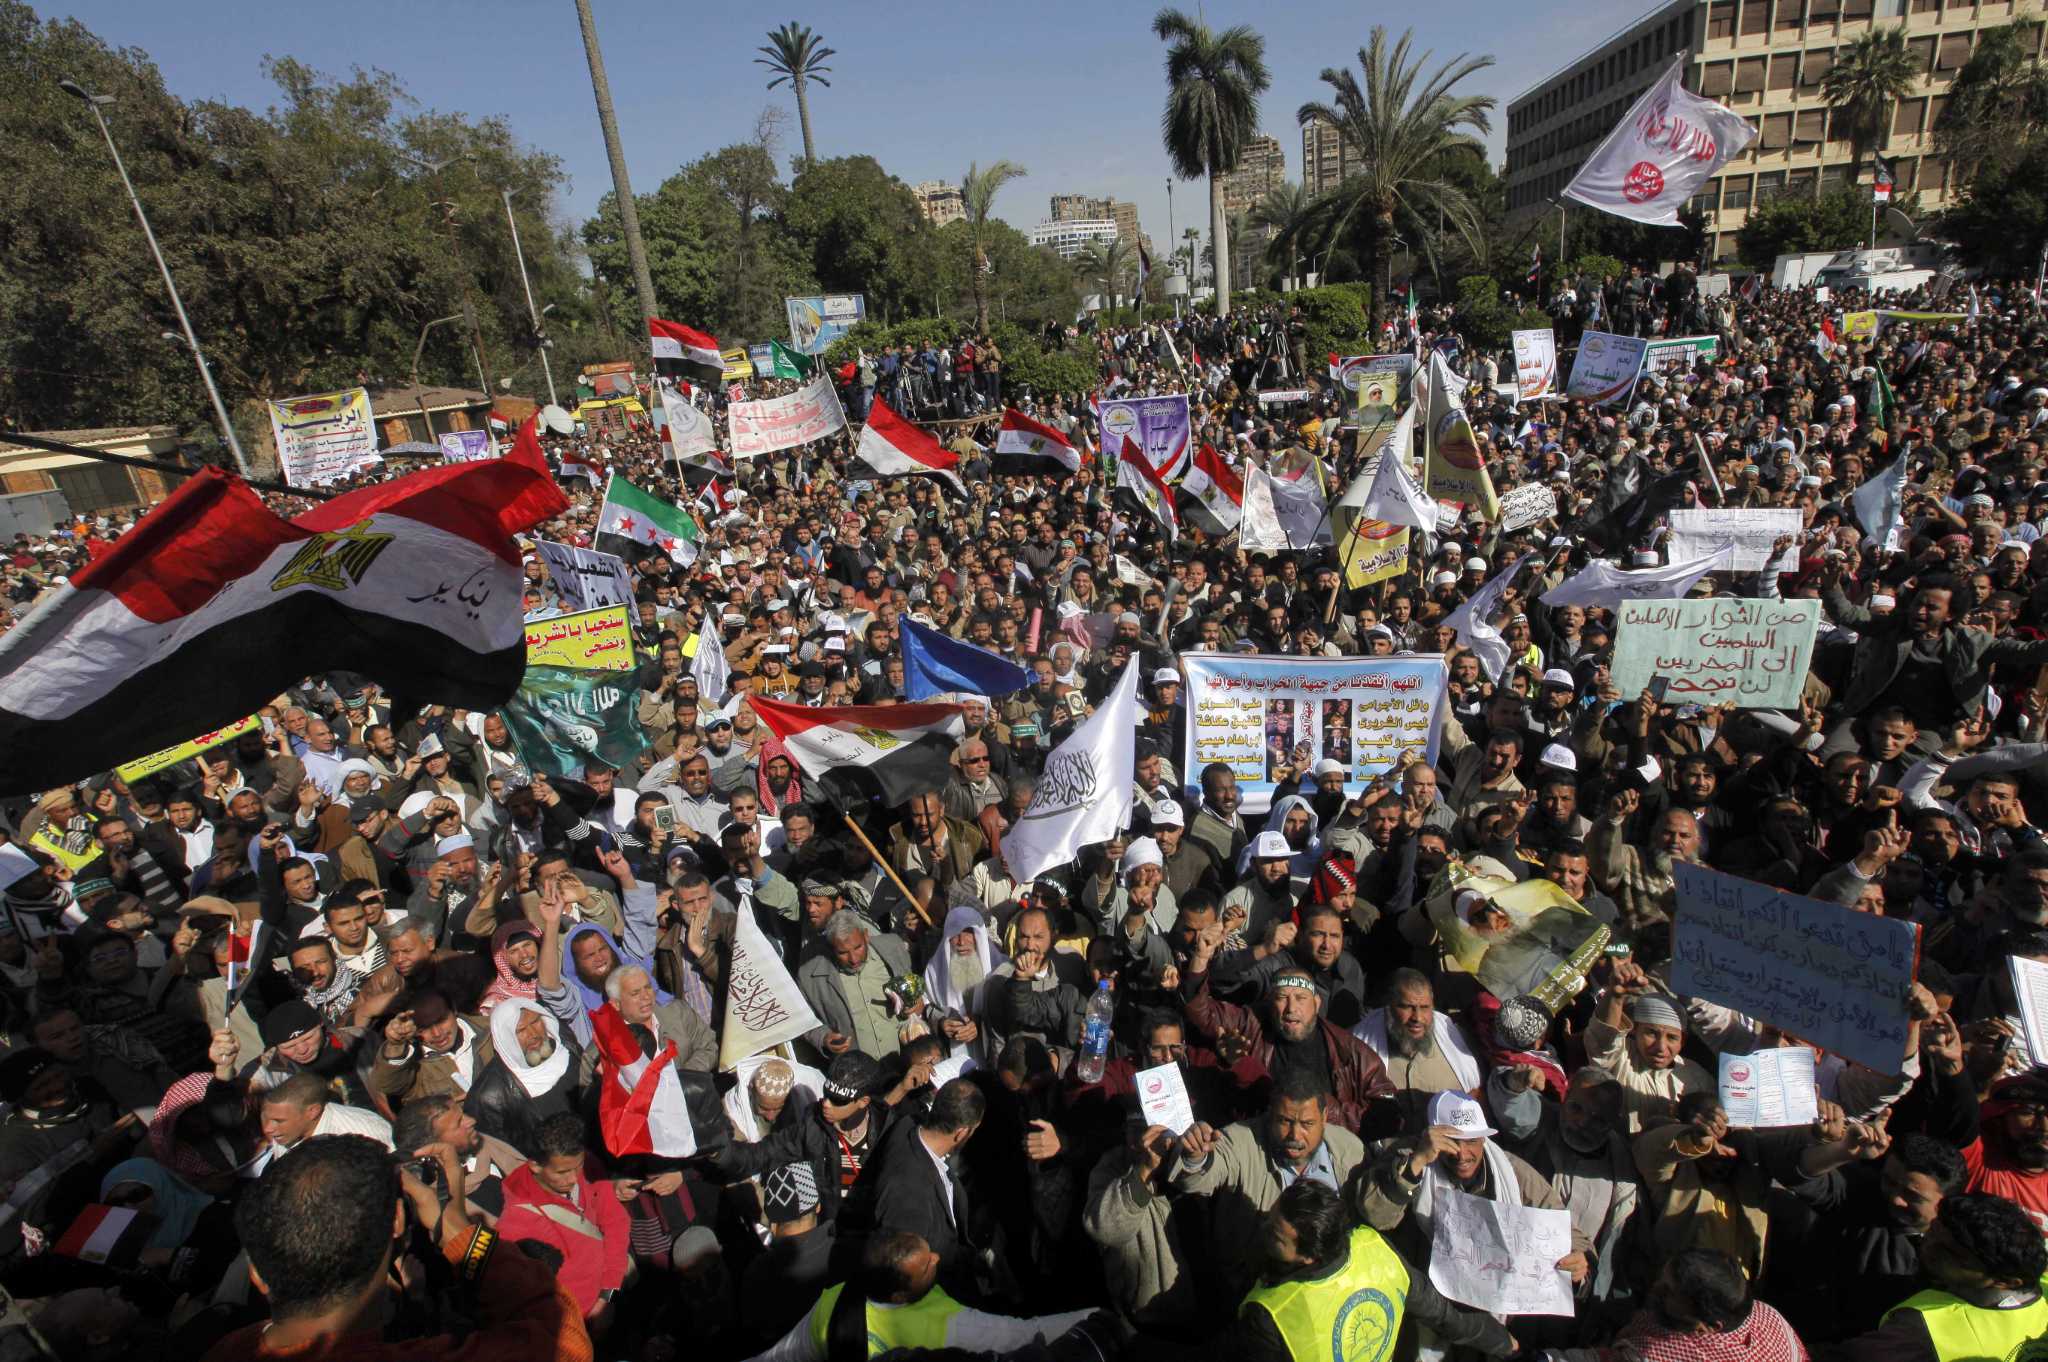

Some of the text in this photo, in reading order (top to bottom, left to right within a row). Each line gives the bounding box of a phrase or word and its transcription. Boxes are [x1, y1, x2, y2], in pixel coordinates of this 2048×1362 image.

[1684, 603, 1761, 631] الثوار
[526, 613, 625, 650] سنحيا بالشريع
[1257, 675, 1297, 694] الخراب
[1298, 674, 1329, 693] جبهة
[1330, 675, 1350, 694] من
[1391, 674, 1424, 695] اللهم
[1739, 674, 1772, 695] لن
